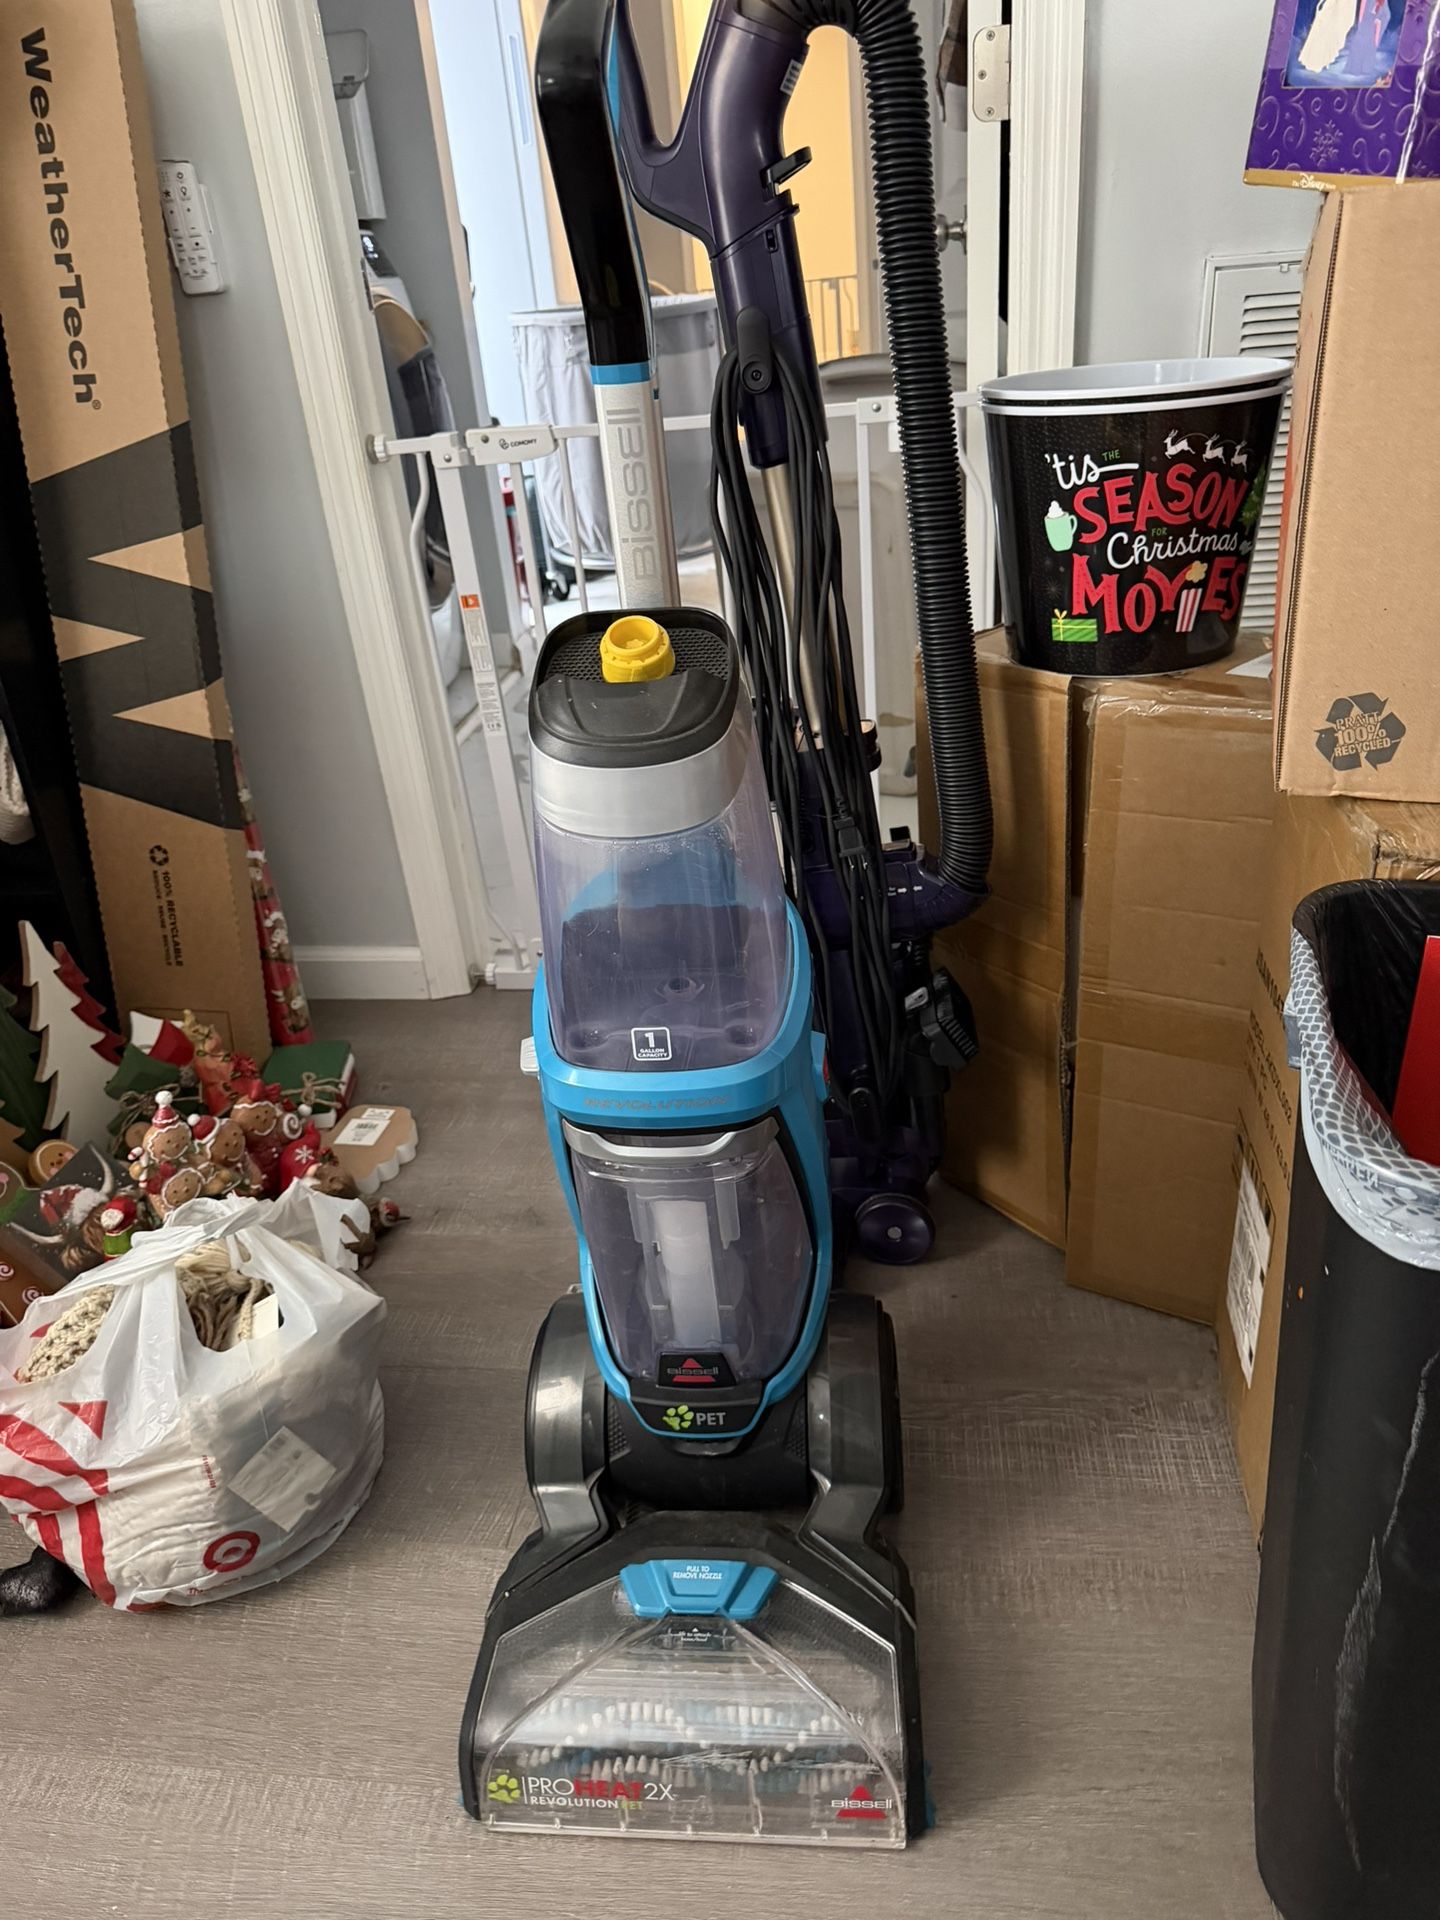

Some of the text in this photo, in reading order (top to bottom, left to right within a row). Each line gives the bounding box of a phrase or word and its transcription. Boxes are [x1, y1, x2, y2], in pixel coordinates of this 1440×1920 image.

[1101, 449, 1121, 462] THE
[1072, 463, 1249, 545] SEASON
[1151, 526, 1168, 537] FOR
[1106, 528, 1239, 569] Christmas
[1335, 711, 1380, 731] PRATT
[1334, 722, 1387, 747] 100%
[1334, 737, 1391, 757] RECYCLED
[166, 900, 184, 967] RECYCLABLE
[644, 1032, 655, 1048] 1
[695, 1412, 726, 1425] PET
[672, 1571, 697, 1579] REMOVE
[528, 1777, 674, 1801] PROHEAT 2X
[530, 1796, 619, 1809] REVOLUTION
